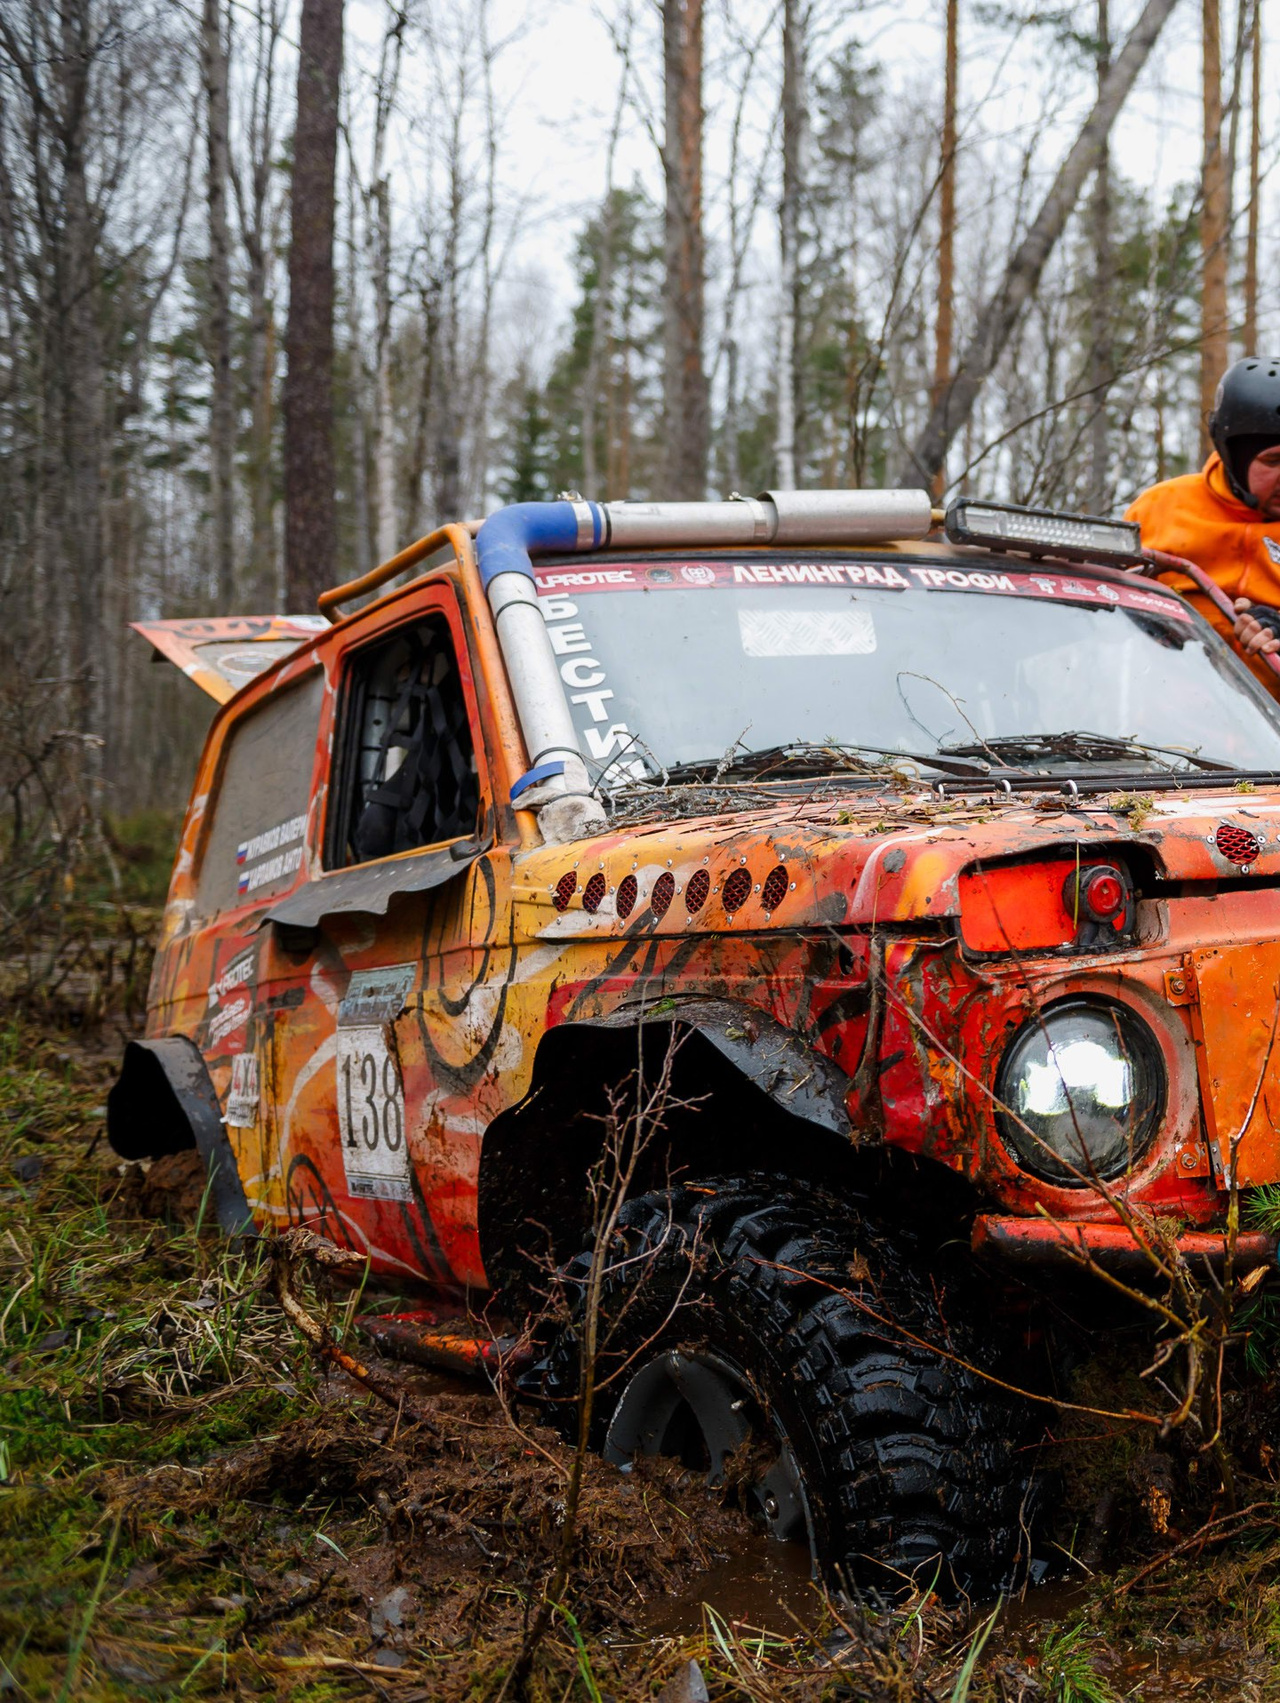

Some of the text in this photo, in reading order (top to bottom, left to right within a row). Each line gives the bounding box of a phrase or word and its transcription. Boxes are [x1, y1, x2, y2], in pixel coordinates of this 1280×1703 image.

[536, 571, 636, 588] UPROTEC
[733, 565, 1016, 591] ЛЕНИНГРАД ТРОФИ
[342, 1053, 402, 1153] 138
